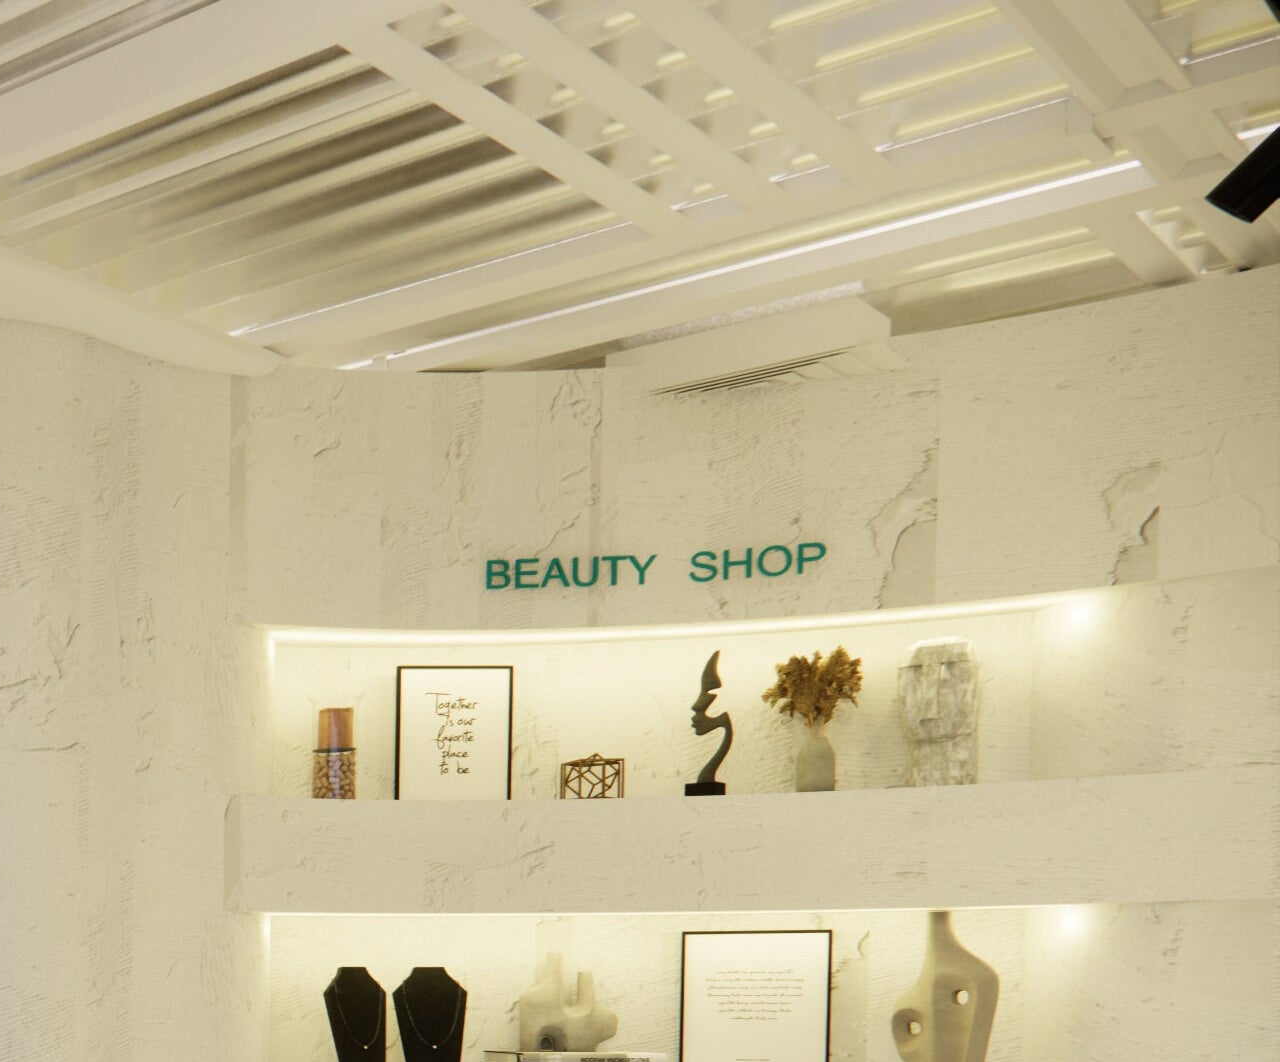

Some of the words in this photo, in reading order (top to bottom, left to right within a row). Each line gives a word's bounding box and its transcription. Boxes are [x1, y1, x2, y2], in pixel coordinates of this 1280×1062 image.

[485, 554, 657, 590] BEAUTY
[689, 542, 827, 583] SHOP
[425, 692, 478, 719] Together
[445, 719, 454, 727] is
[457, 718, 476, 726] our
[433, 725, 475, 750] favorite
[441, 745, 470, 763] place
[439, 763, 449, 775] to
[457, 761, 470, 774] be
